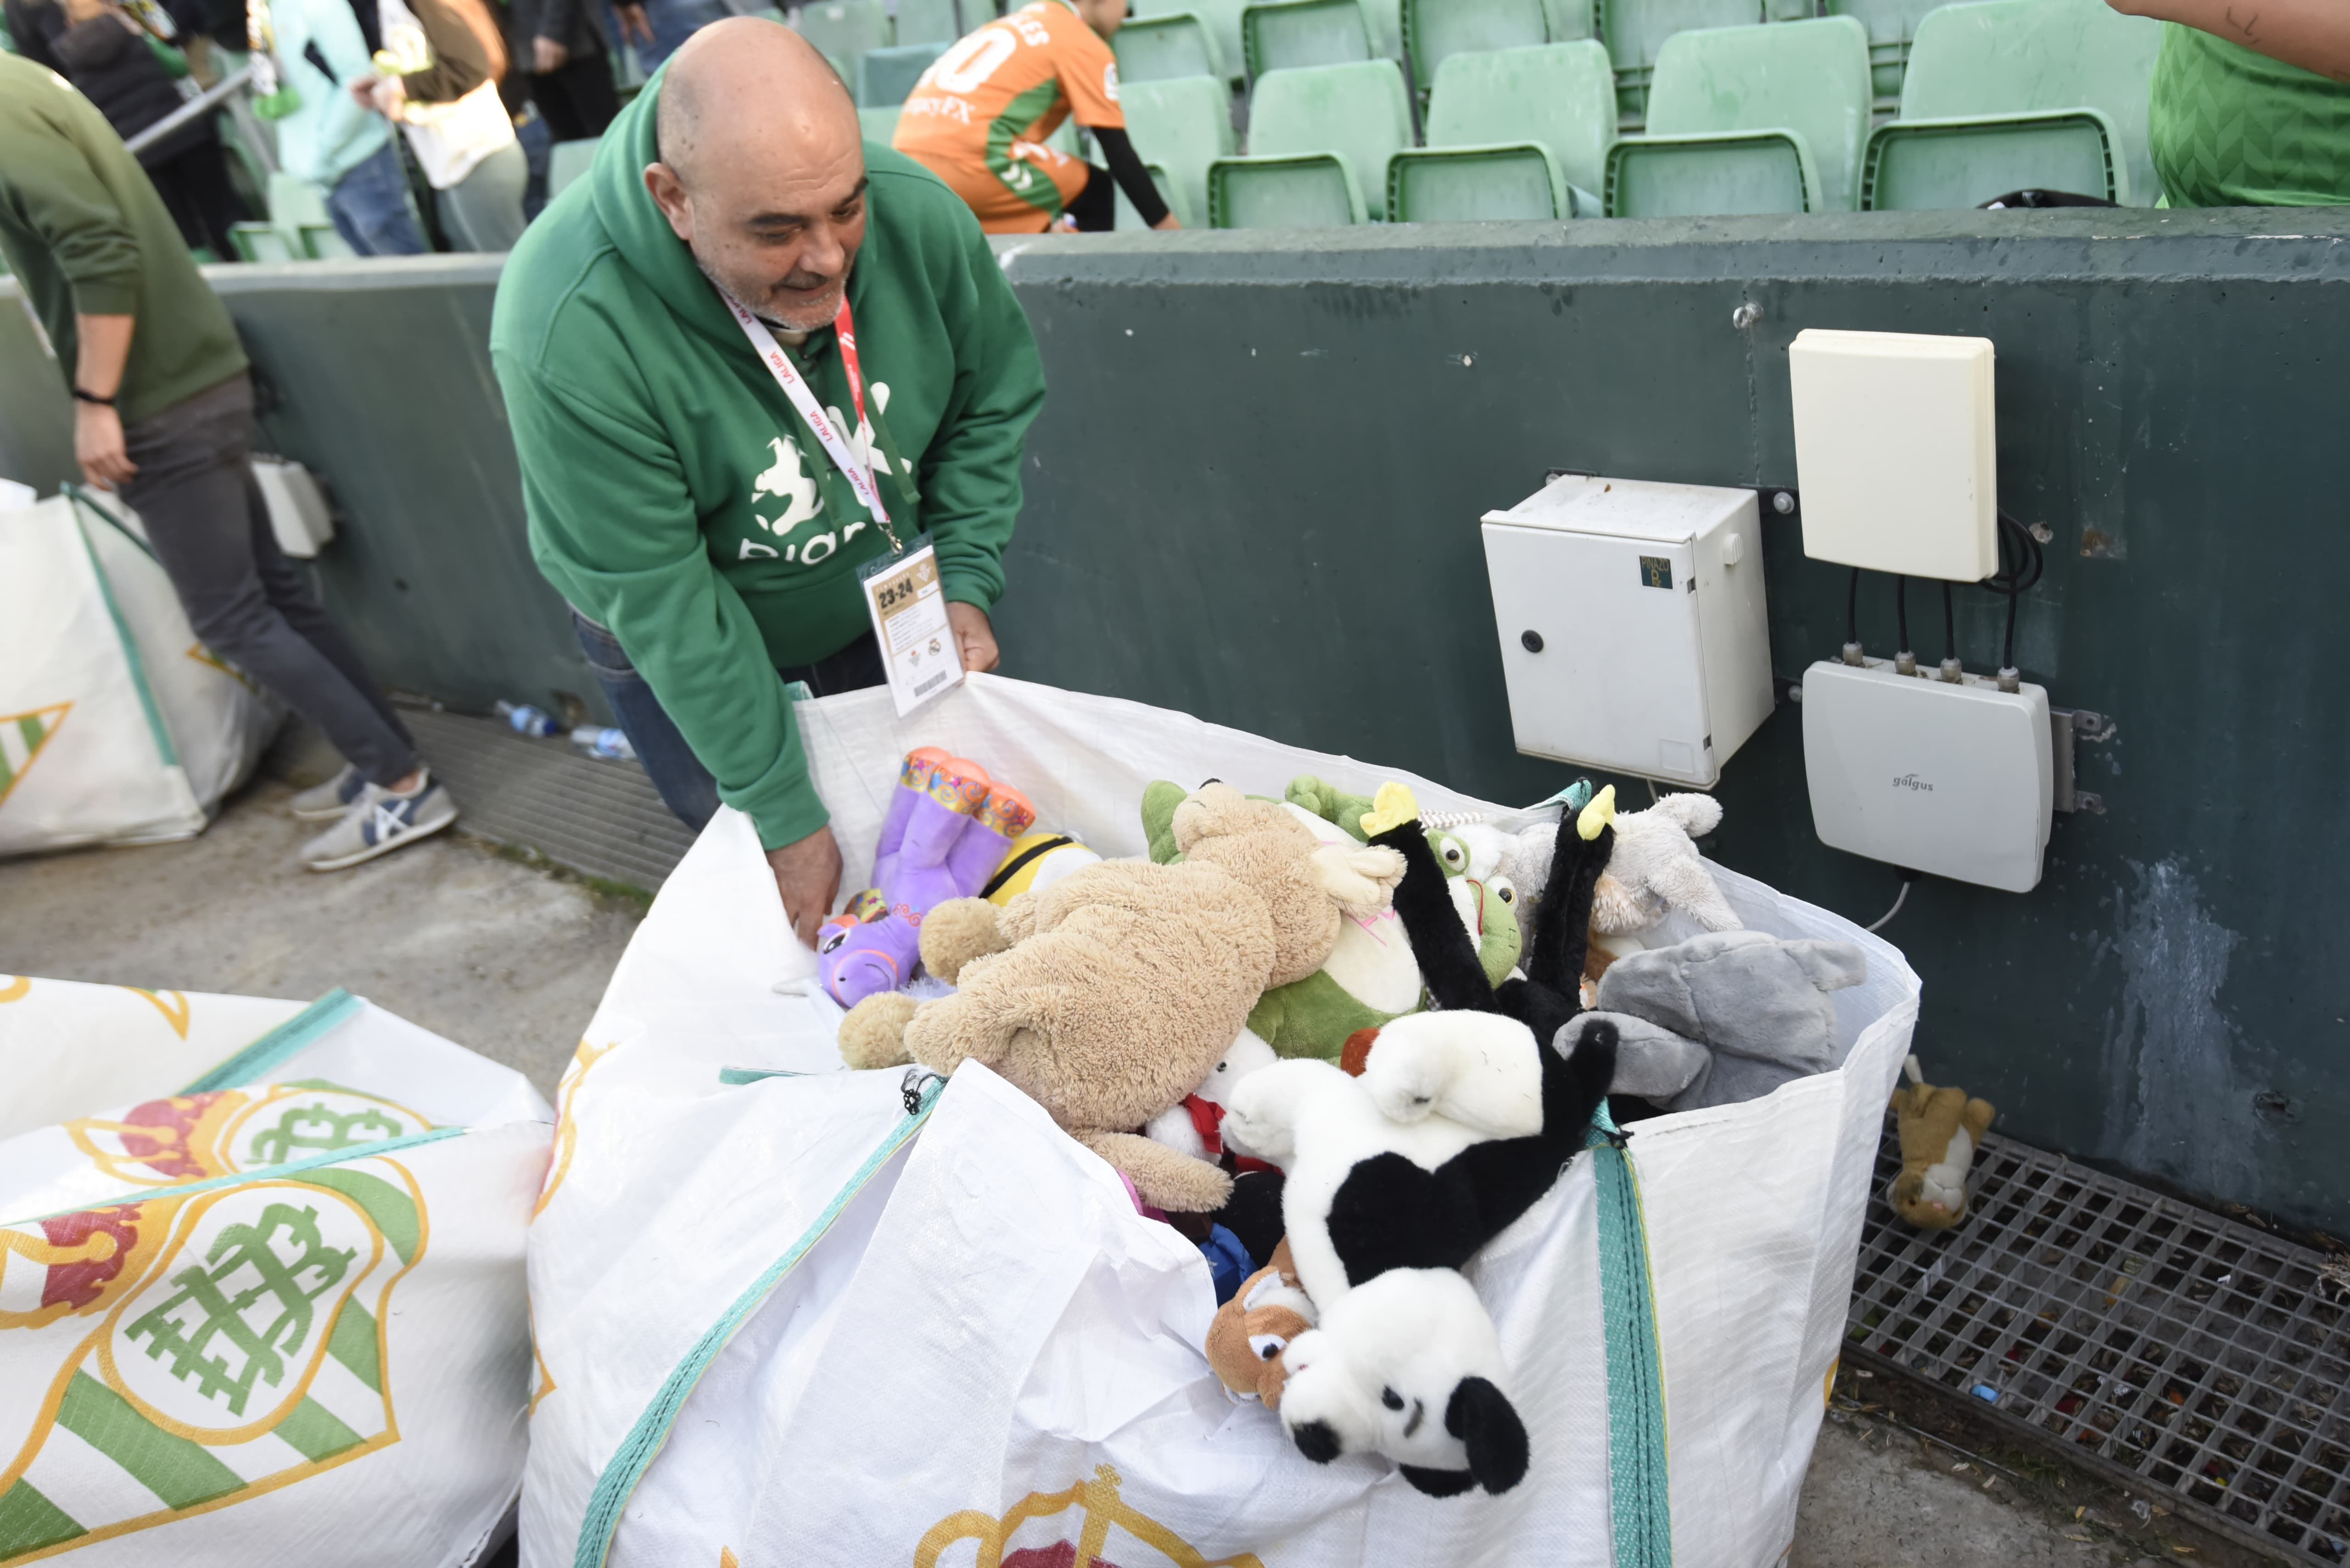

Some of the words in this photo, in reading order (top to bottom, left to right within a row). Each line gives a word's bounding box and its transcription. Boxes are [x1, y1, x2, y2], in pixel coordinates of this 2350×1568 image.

[770, 351, 795, 384] LALIGA
[810, 411, 833, 441] LALIGA
[847, 467, 869, 495] LALIGA
[1641, 556, 1669, 572] PINAZO
[878, 577, 913, 609] 23-24
[1892, 776, 1934, 791] galgus
